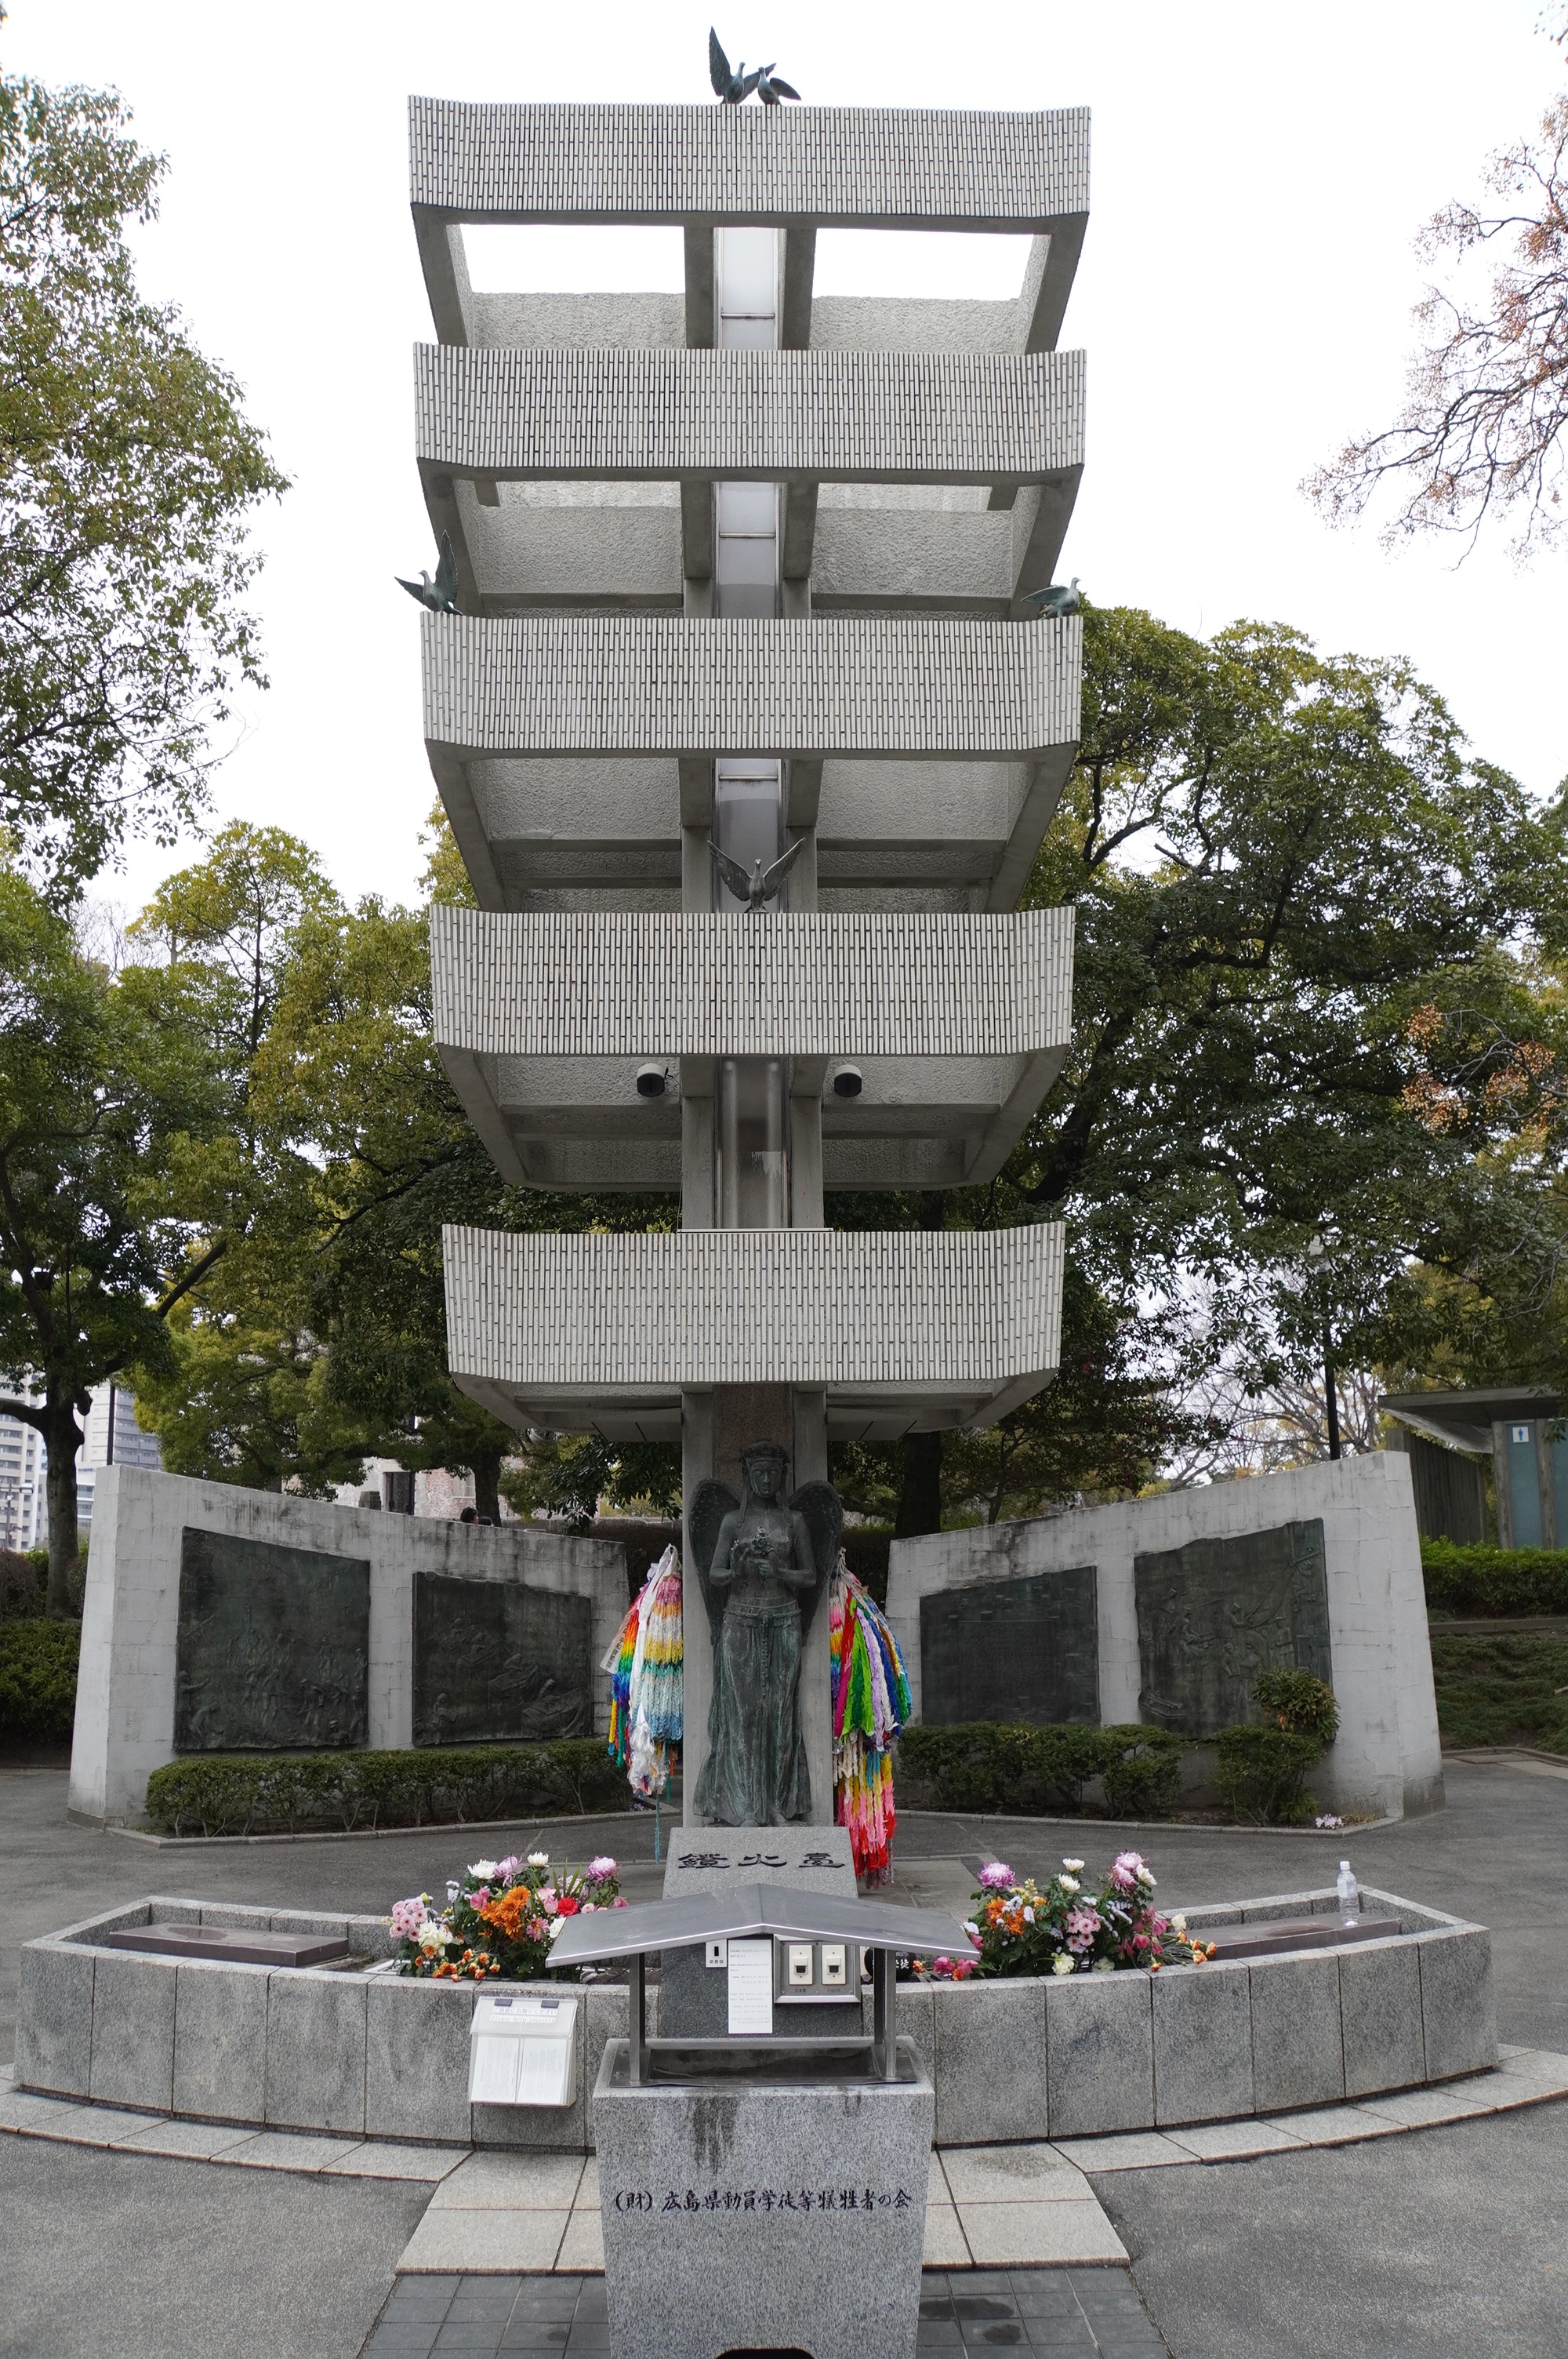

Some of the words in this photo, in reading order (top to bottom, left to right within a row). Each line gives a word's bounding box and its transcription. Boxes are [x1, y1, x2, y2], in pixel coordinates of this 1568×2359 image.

[615, 2190, 653, 2212] (財)
[661, 2189, 913, 2212] 広島県動員学徒等犠牲者の会
